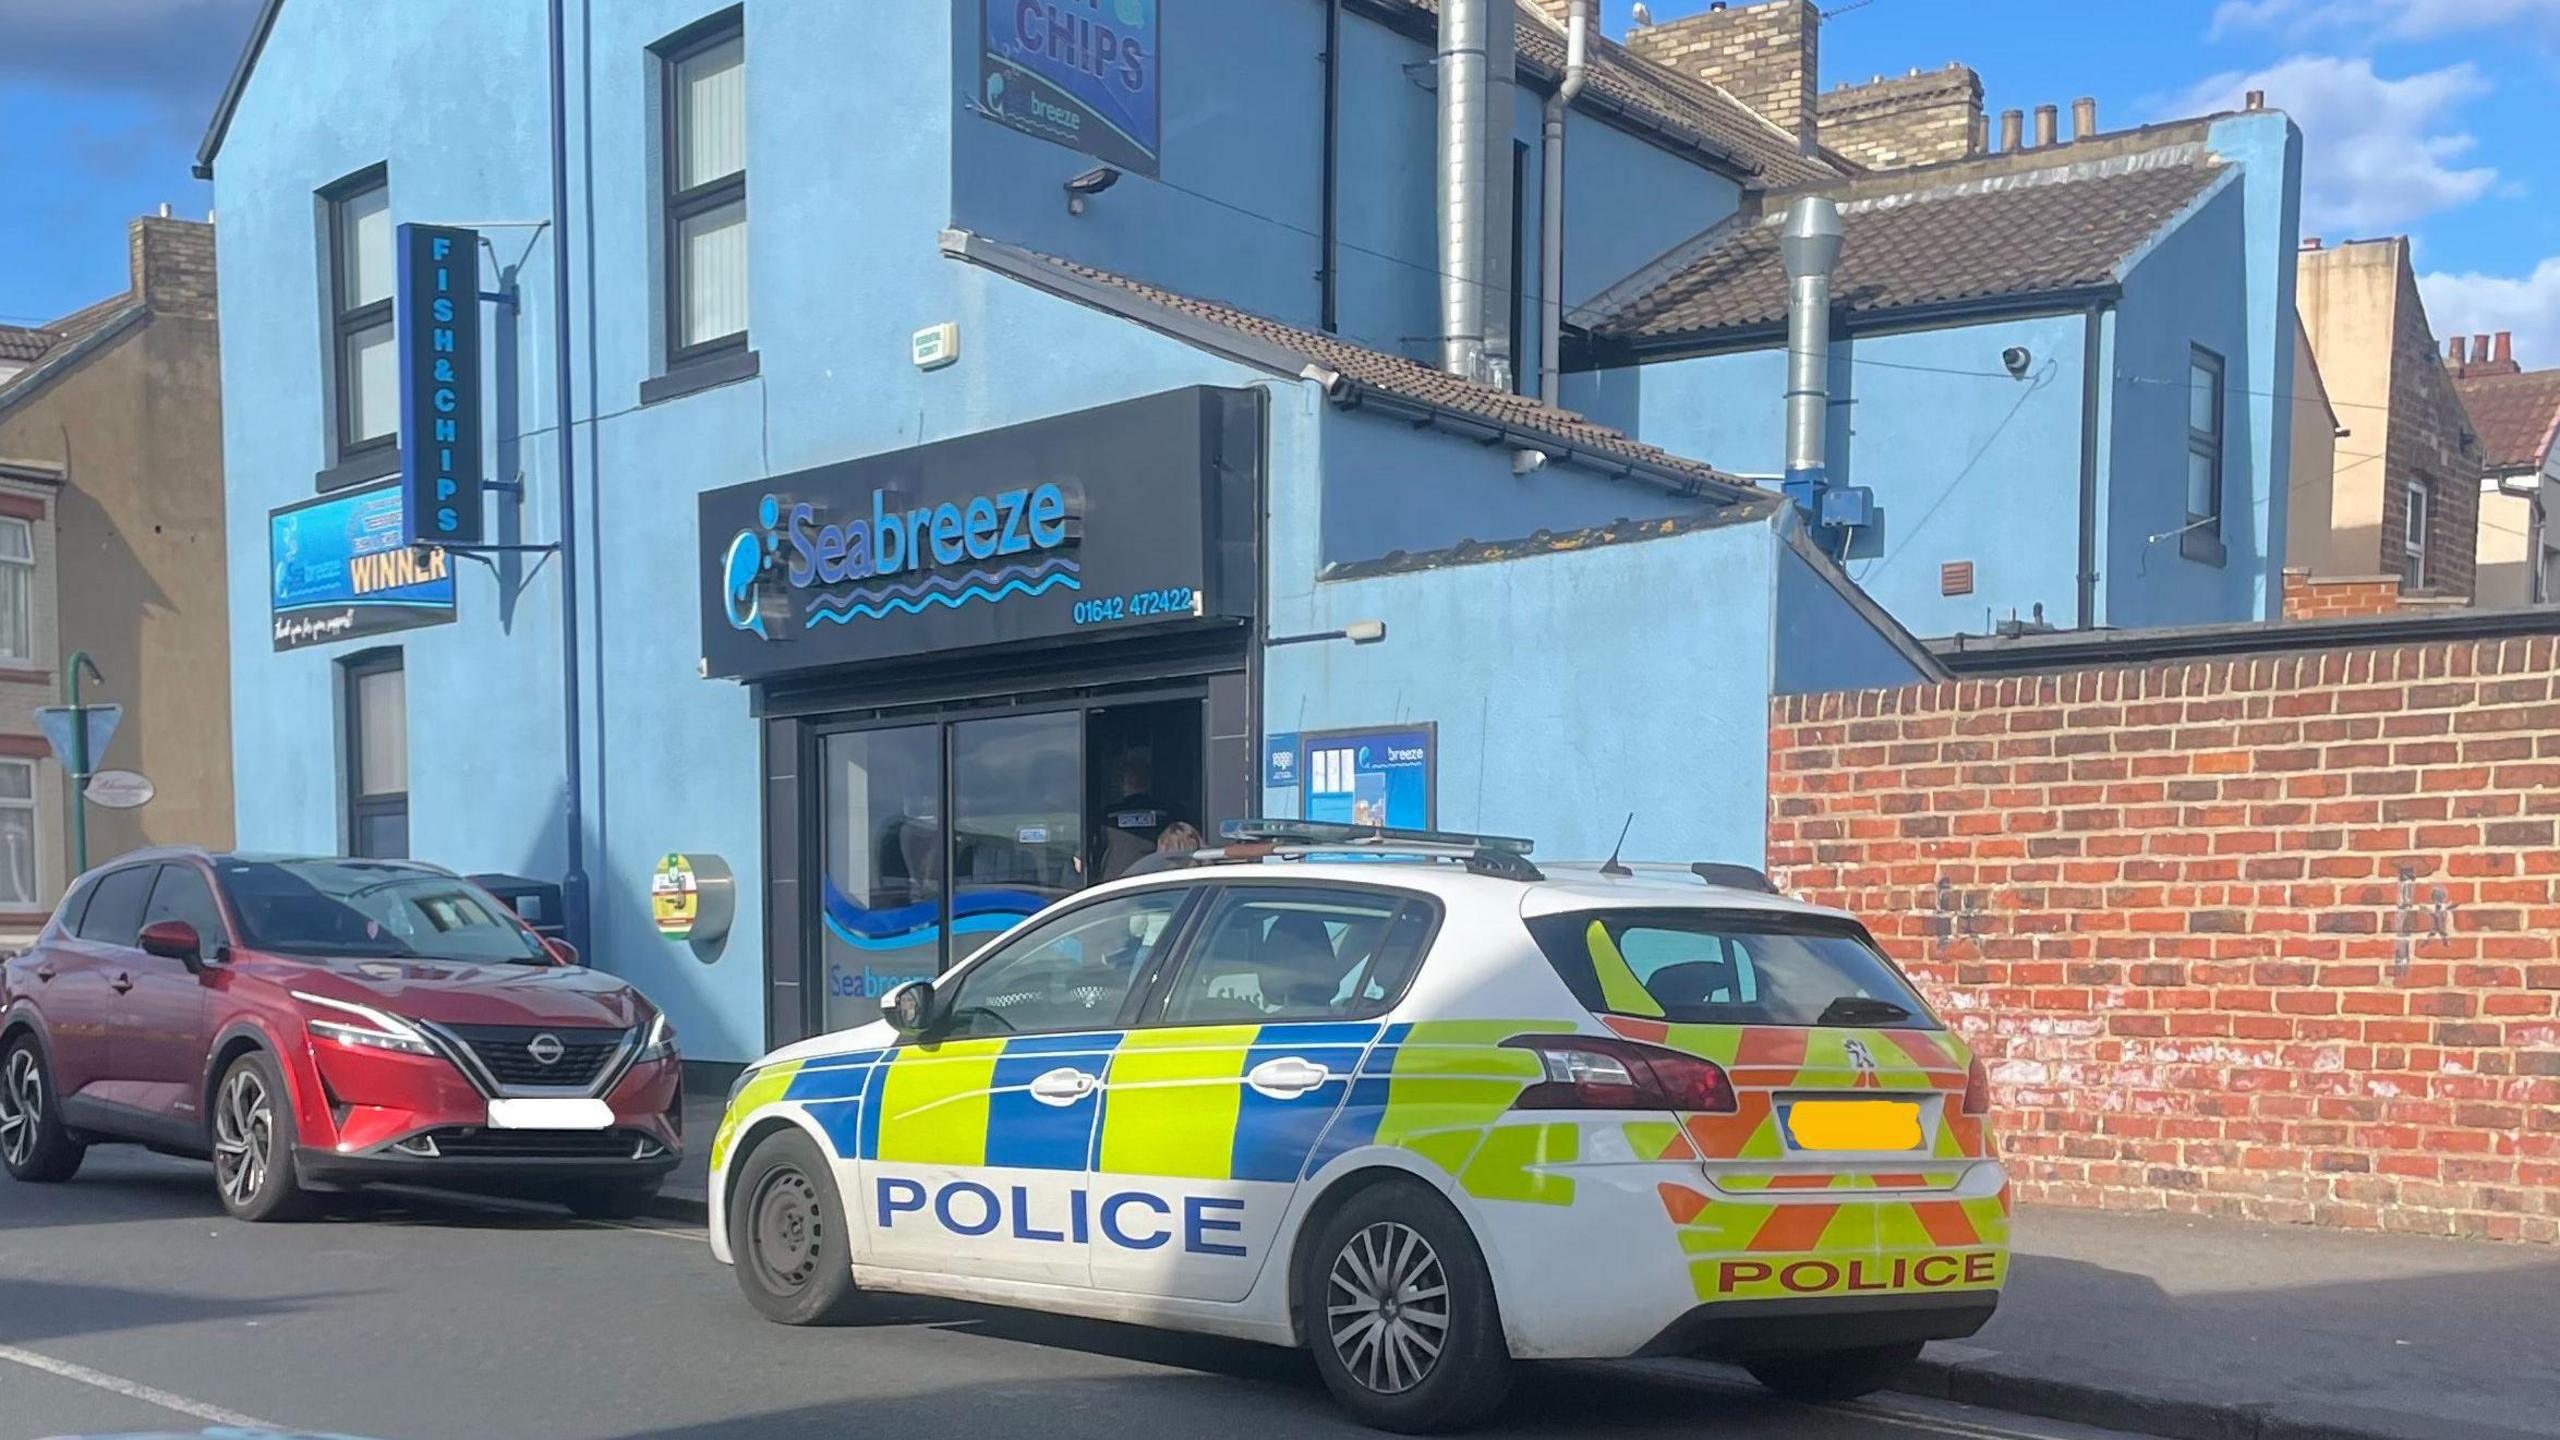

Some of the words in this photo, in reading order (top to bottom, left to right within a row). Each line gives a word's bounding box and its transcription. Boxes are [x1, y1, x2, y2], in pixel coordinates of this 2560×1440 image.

[1015, 0, 1145, 93] CHIPS
[788, 482, 1065, 588] Seabreeze
[1073, 596, 1124, 624] 01642
[1129, 587, 1191, 616] 472422
[876, 1177, 1247, 1257] POLICE
[1717, 1252, 1996, 1293] POLICE
